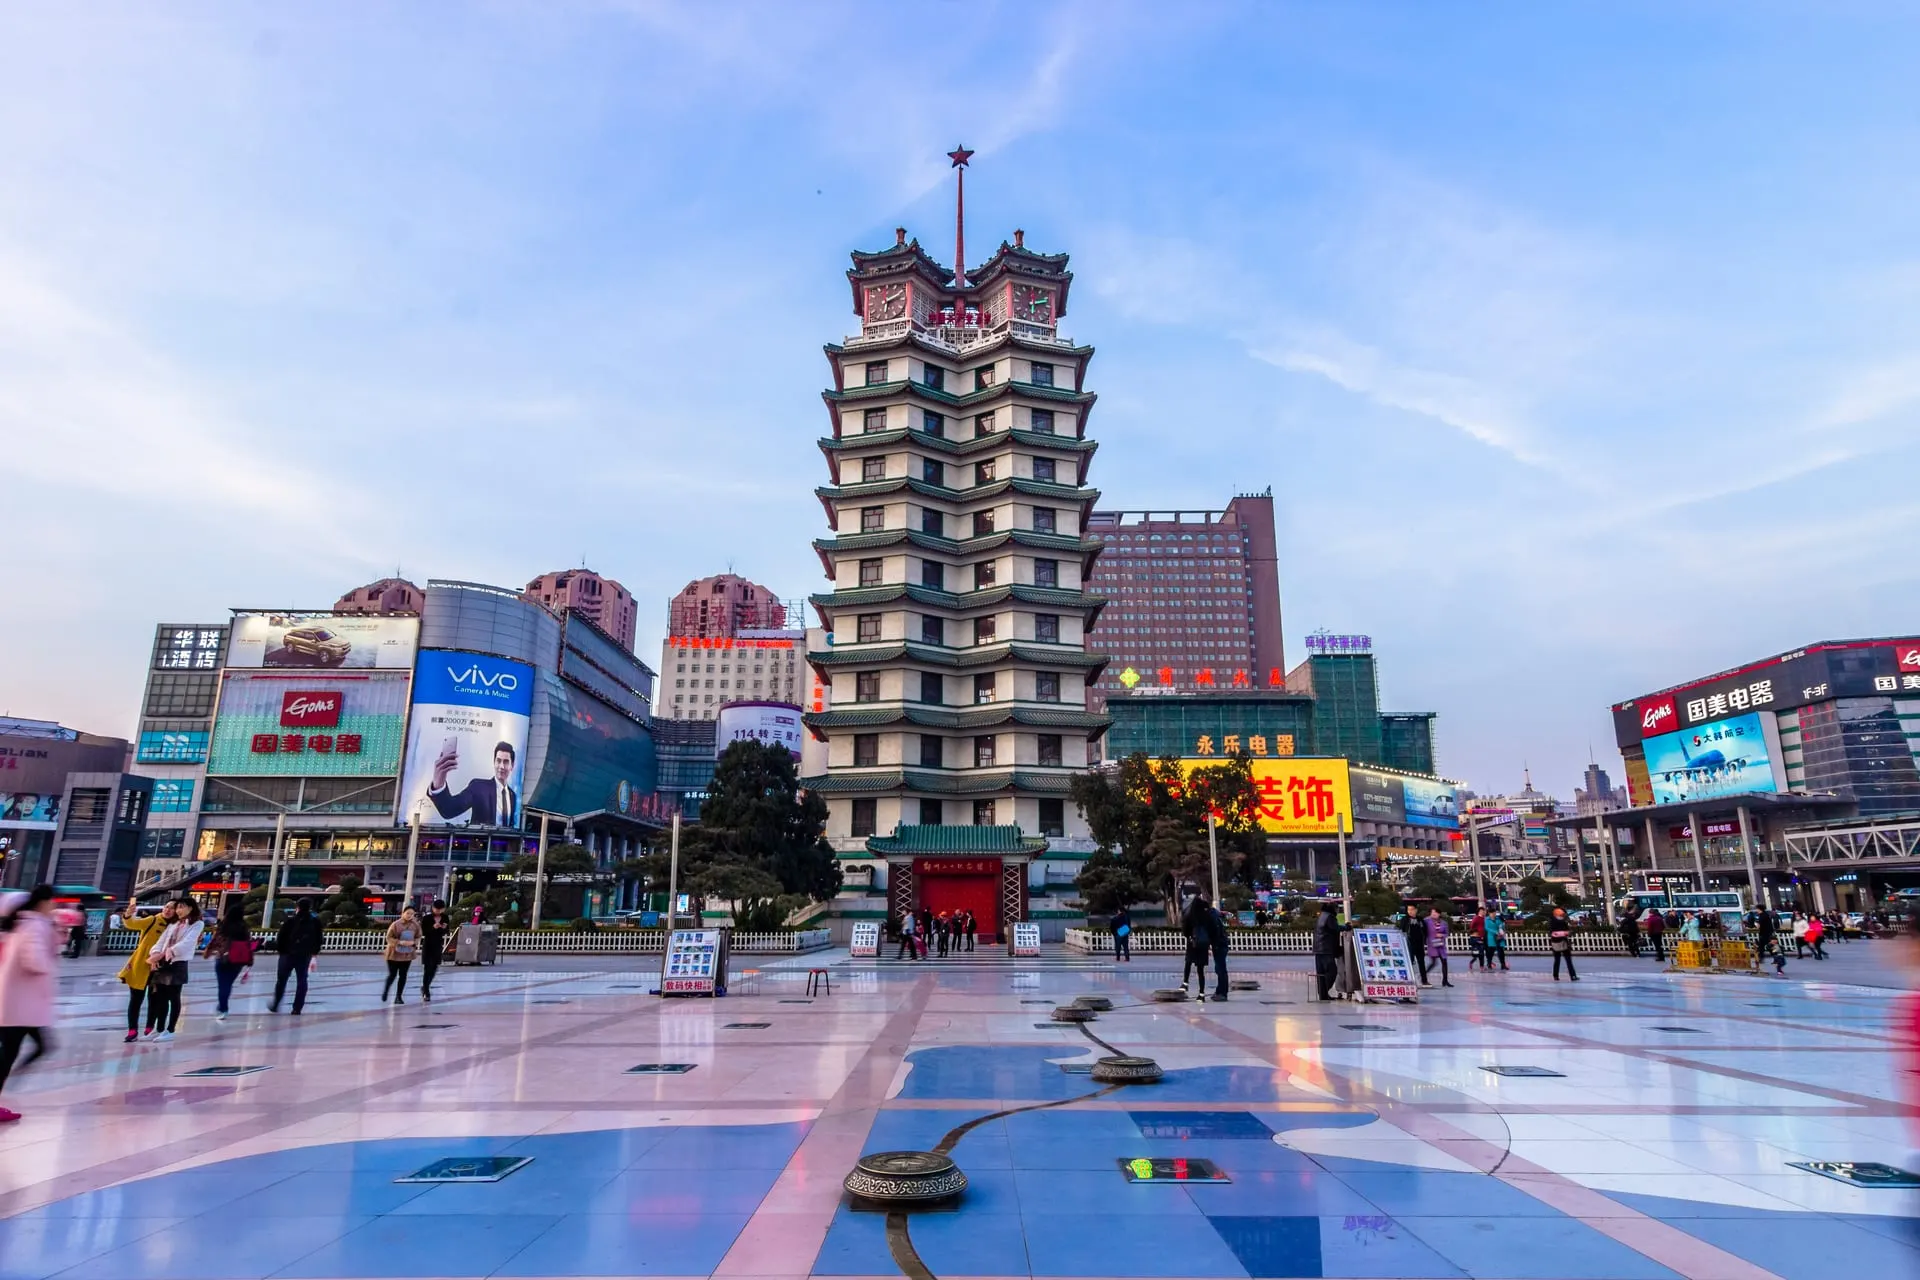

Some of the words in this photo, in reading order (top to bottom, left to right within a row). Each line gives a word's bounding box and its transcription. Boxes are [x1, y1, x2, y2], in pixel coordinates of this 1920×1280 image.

[174, 631, 219, 648] 华联
[448, 664, 518, 691] vivo
[454, 686, 483, 695] Camera
[491, 690, 510, 699] Music
[1687, 680, 1775, 723] 国美电器
[734, 729, 754, 739] 114
[1703, 727, 1745, 743] 大韩航空
[251, 734, 362, 754] 国美电器
[1197, 734, 1295, 756] 永乐电器
